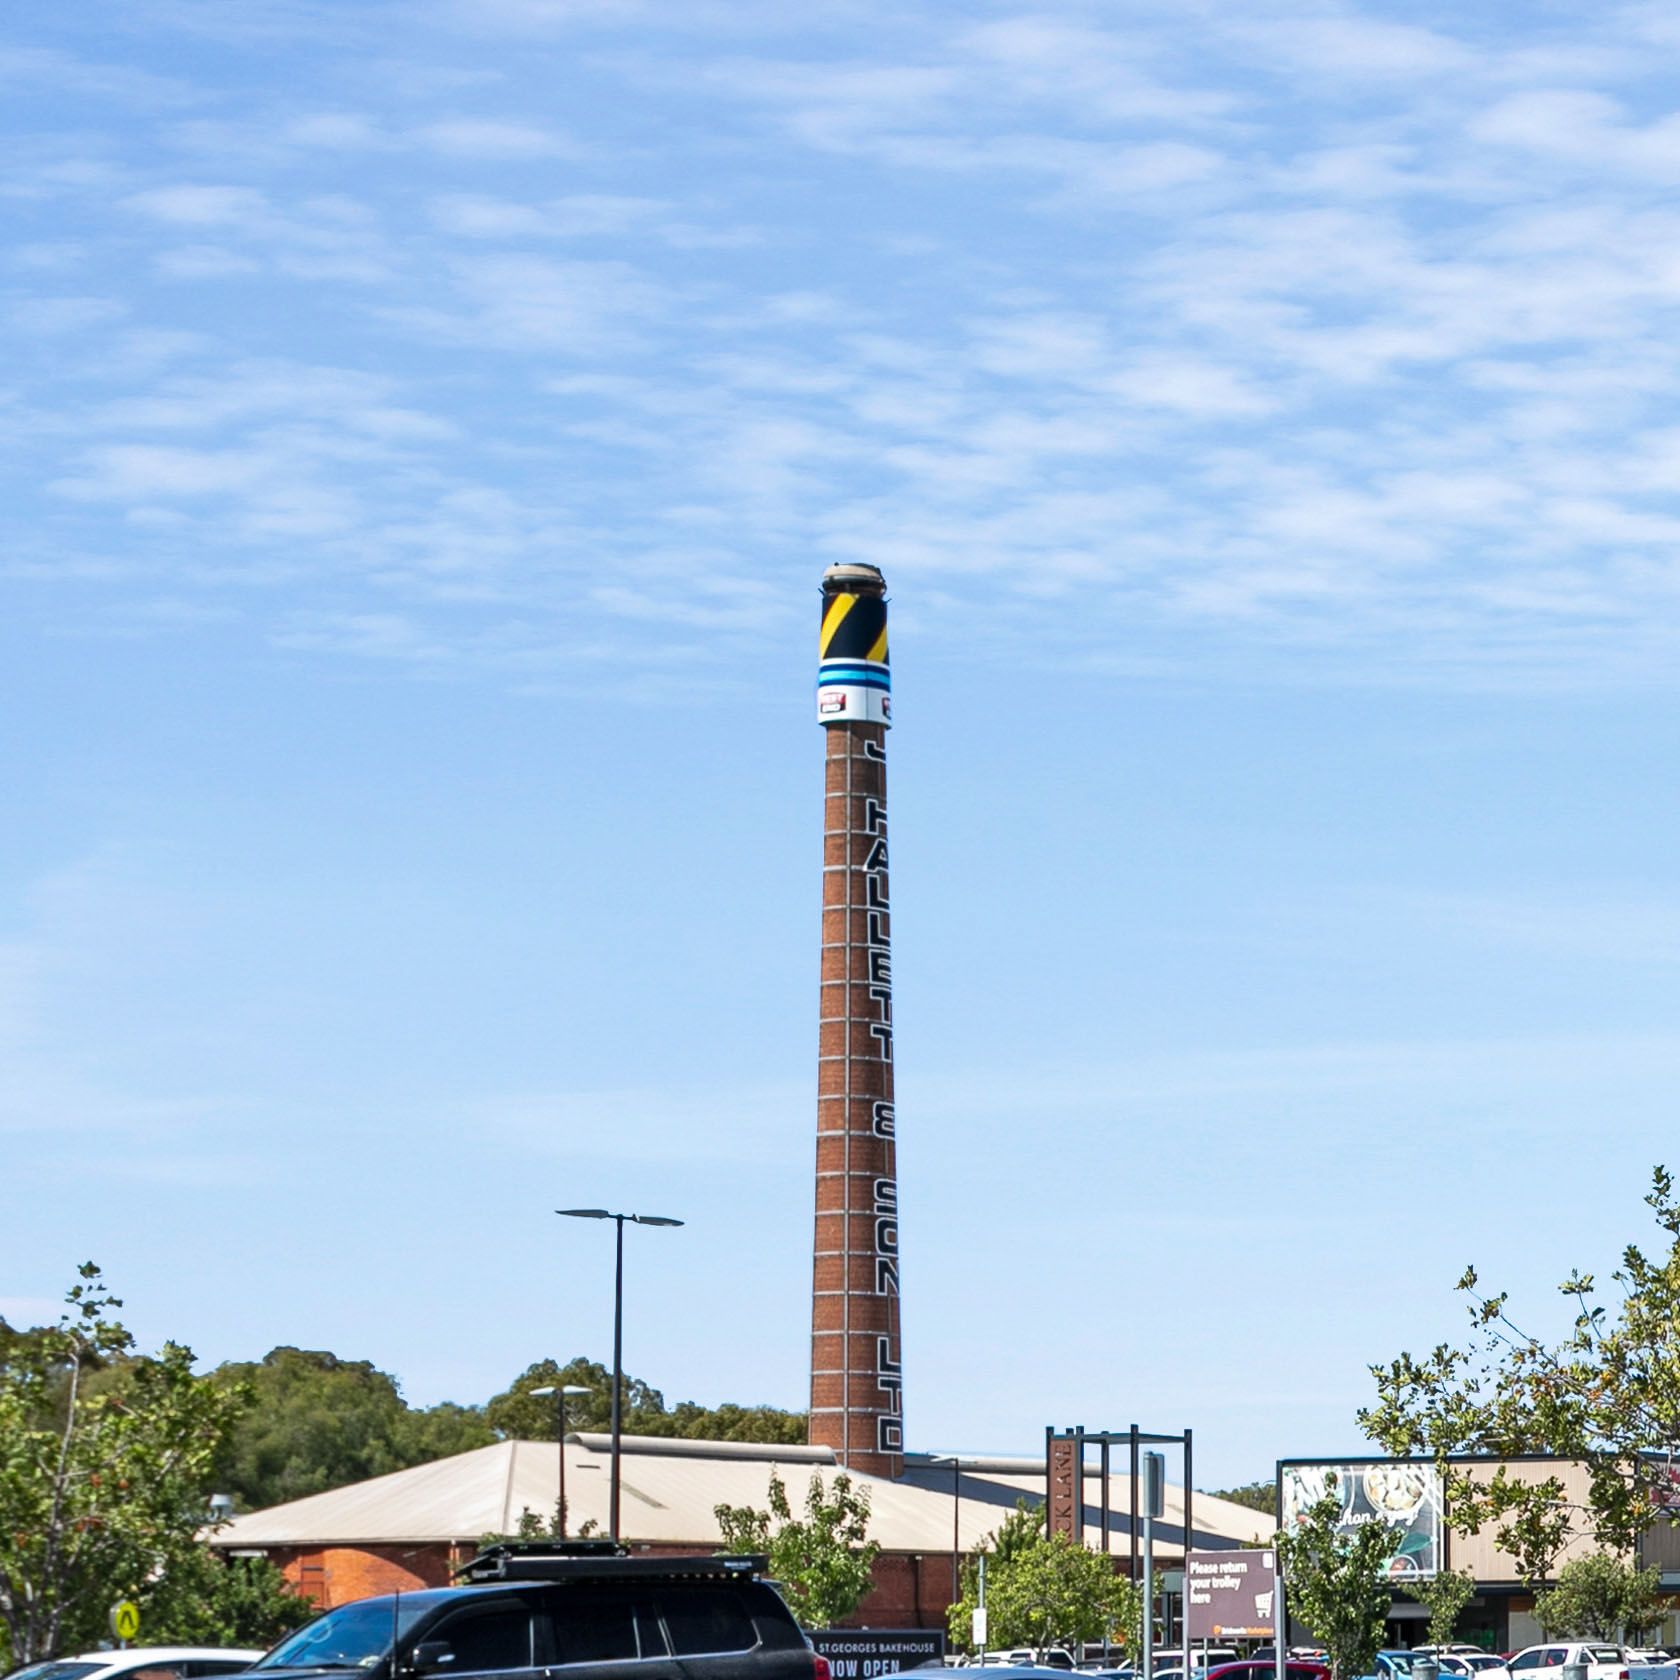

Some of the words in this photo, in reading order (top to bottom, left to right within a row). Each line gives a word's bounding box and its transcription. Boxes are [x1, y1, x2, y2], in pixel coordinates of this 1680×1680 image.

[1189, 1561, 1219, 1574] Please
[1219, 1561, 1248, 1573] return
[1189, 1578, 1211, 1590] your
[1211, 1574, 1241, 1591] trolley
[1189, 1589, 1211, 1604] here
[880, 1643, 934, 1653] BAKEHOUSE
[829, 1659, 858, 1678] NOW
[863, 1659, 900, 1677] OPEN
